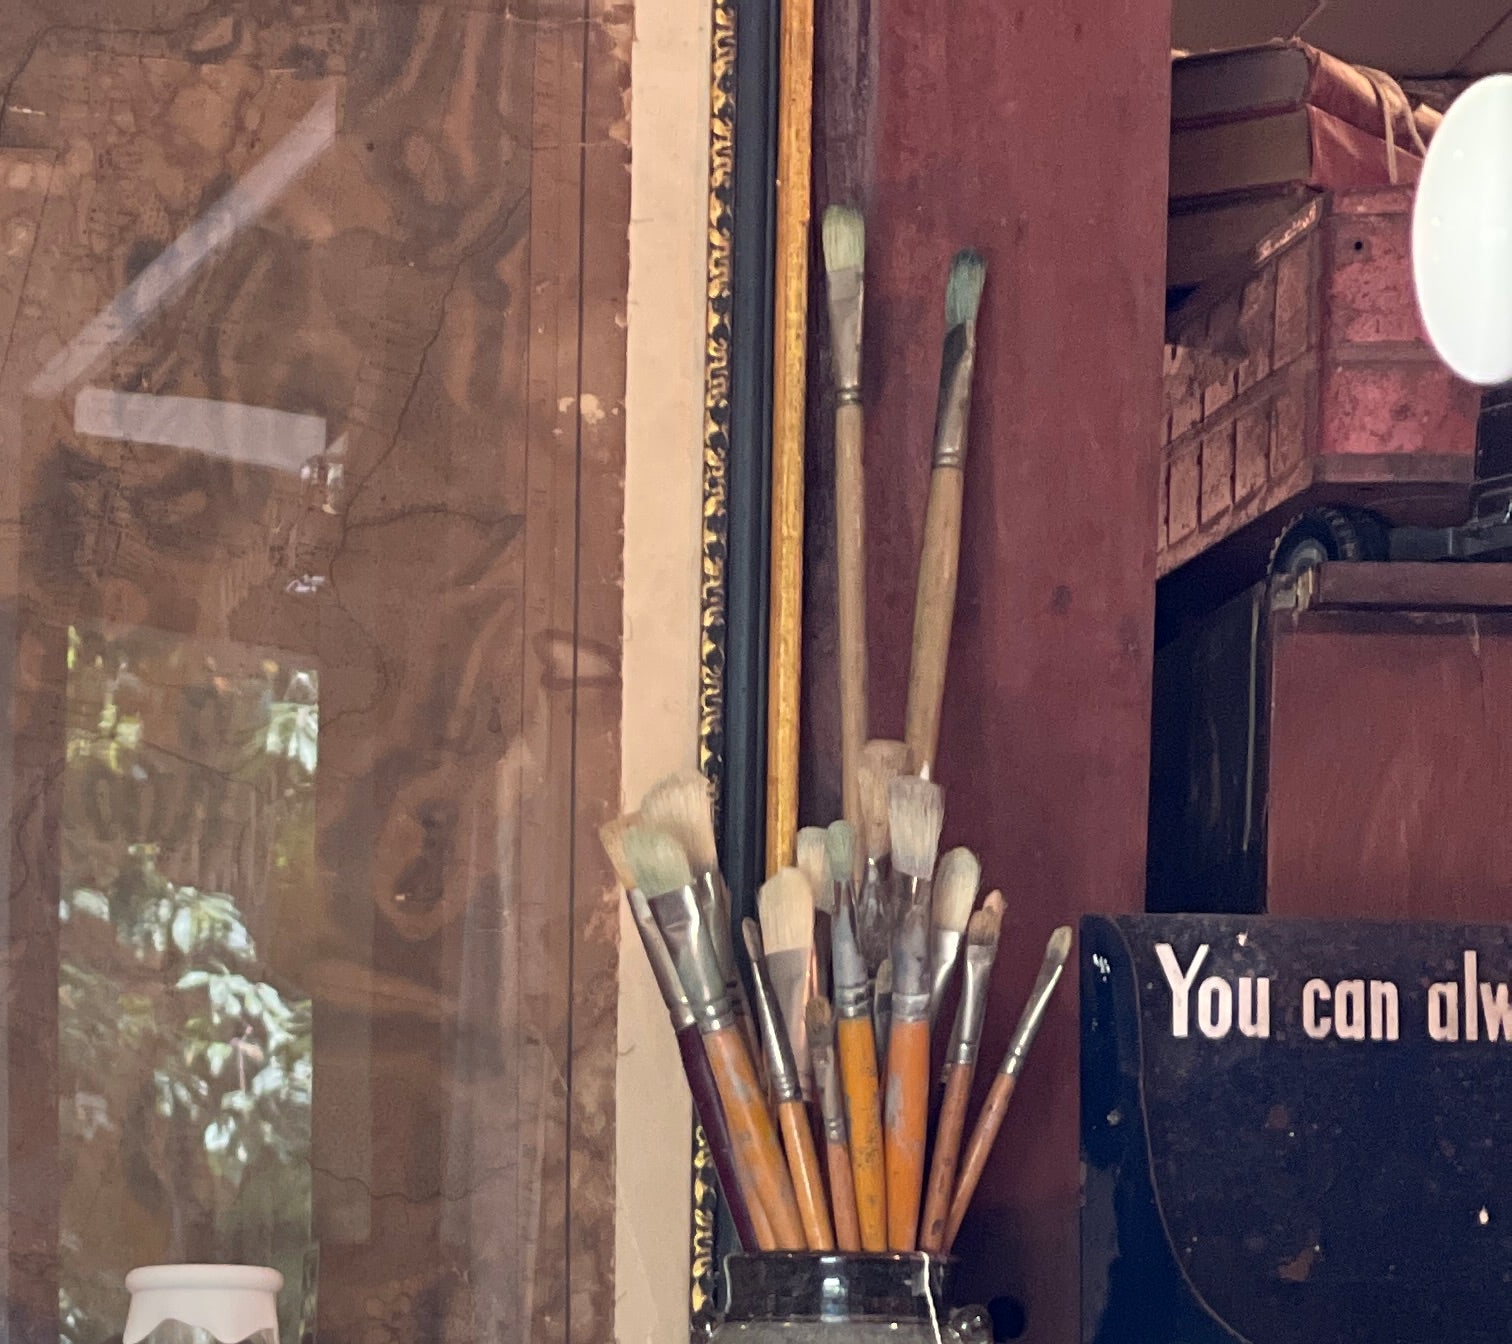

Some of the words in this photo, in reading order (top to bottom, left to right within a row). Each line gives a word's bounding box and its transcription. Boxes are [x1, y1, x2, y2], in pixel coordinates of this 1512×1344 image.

[1155, 942, 1270, 1039] You
[1303, 977, 1399, 1041] can
[1428, 950, 1512, 1042] alw
